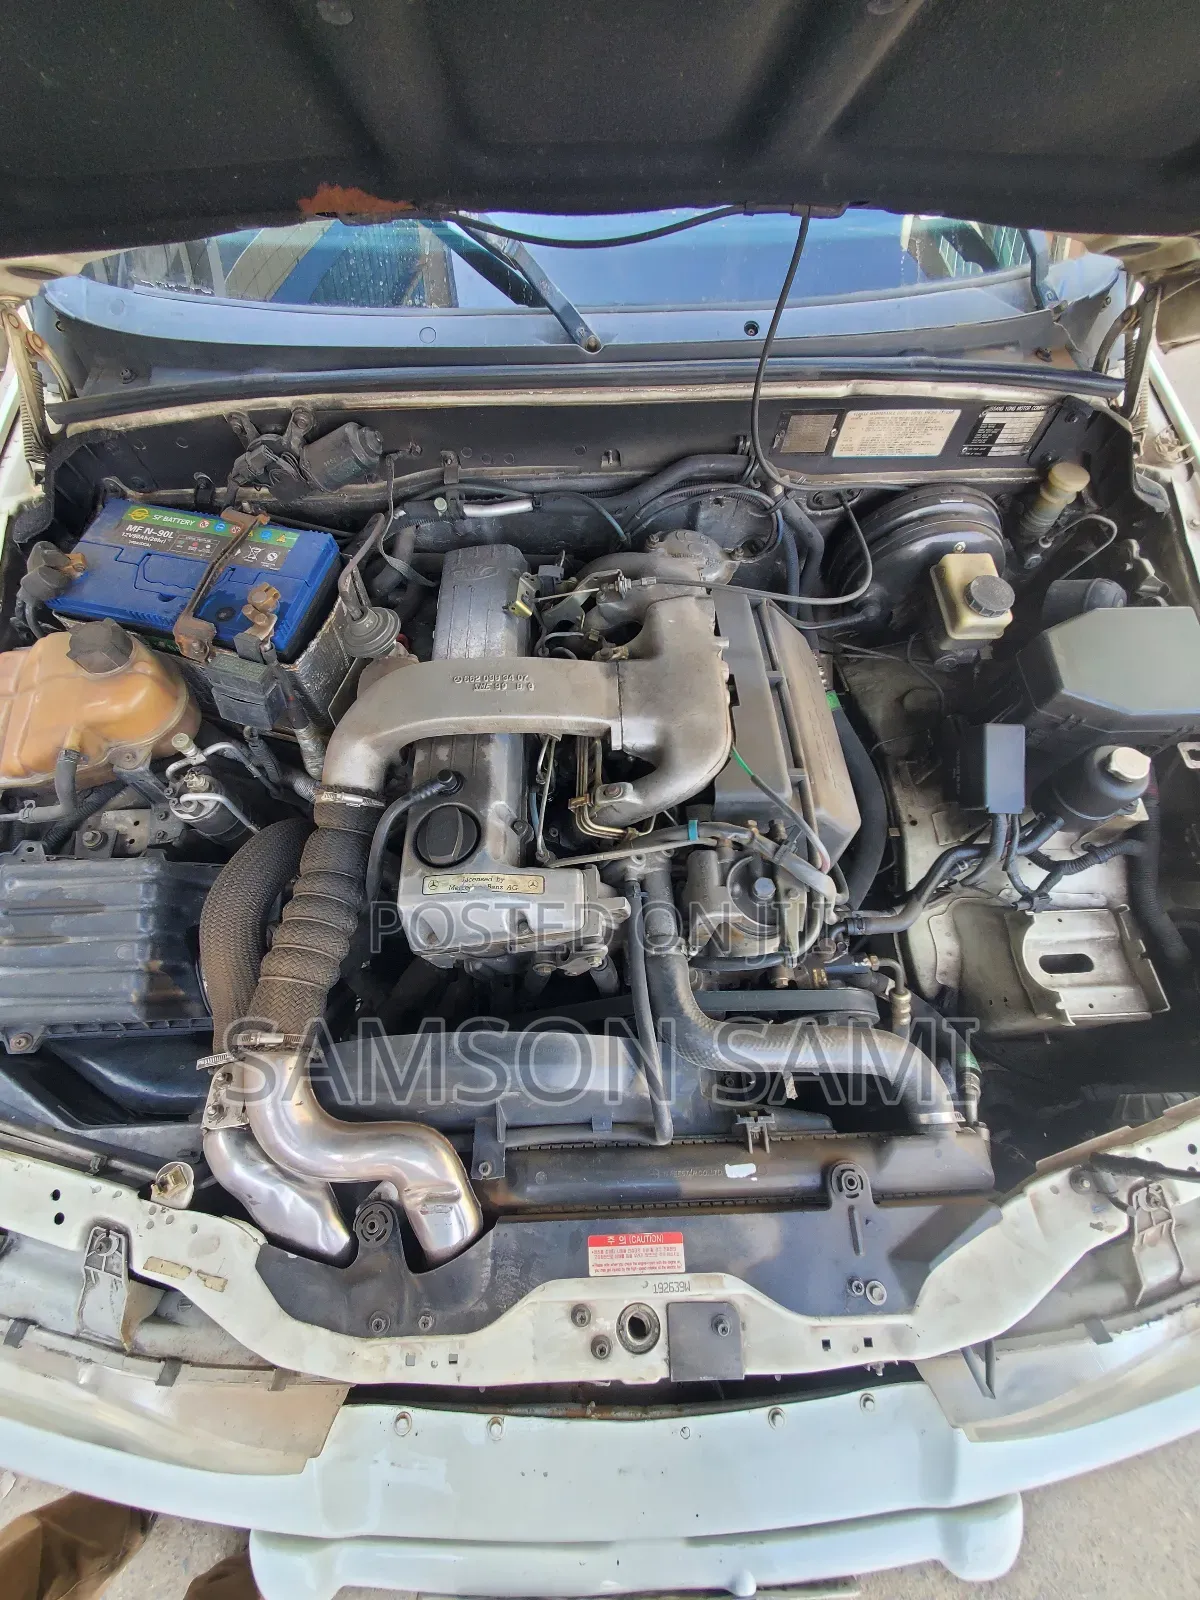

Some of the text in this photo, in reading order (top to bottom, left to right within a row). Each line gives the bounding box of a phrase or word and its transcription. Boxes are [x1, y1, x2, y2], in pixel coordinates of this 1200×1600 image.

[162, 515, 196, 526] BATTERY
[125, 524, 174, 539] MF N-90L
[628, 1233, 664, 1245] (CAUTION)
[652, 1280, 691, 1294] 192639W
